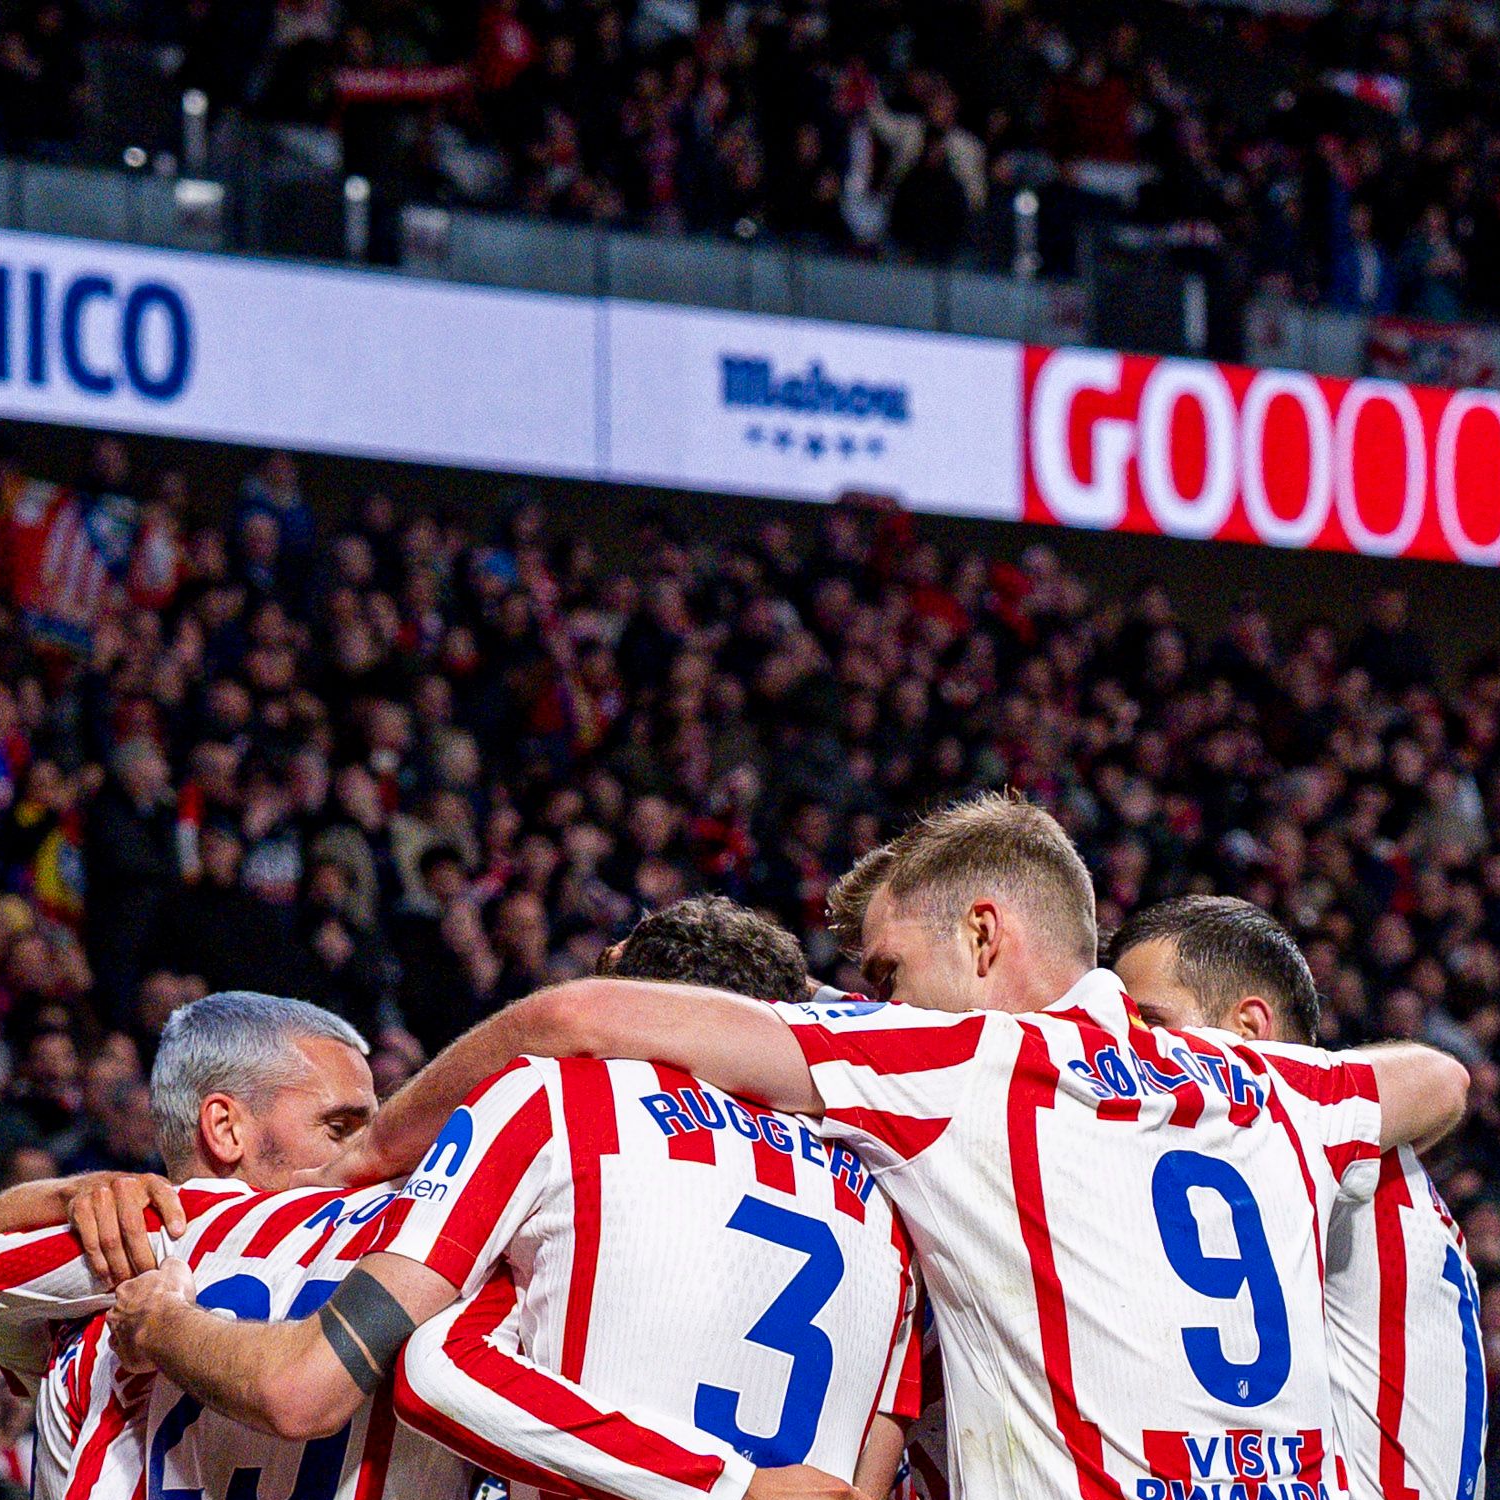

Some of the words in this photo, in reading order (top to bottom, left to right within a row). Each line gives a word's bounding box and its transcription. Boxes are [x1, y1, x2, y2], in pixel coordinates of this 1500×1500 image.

[721, 357, 909, 424] Mahou
[638, 1088, 876, 1204] RUGGERI
[693, 1194, 845, 1468] 3
[1152, 1150, 1292, 1408] 9
[1184, 1435, 1303, 1479] VISIT
